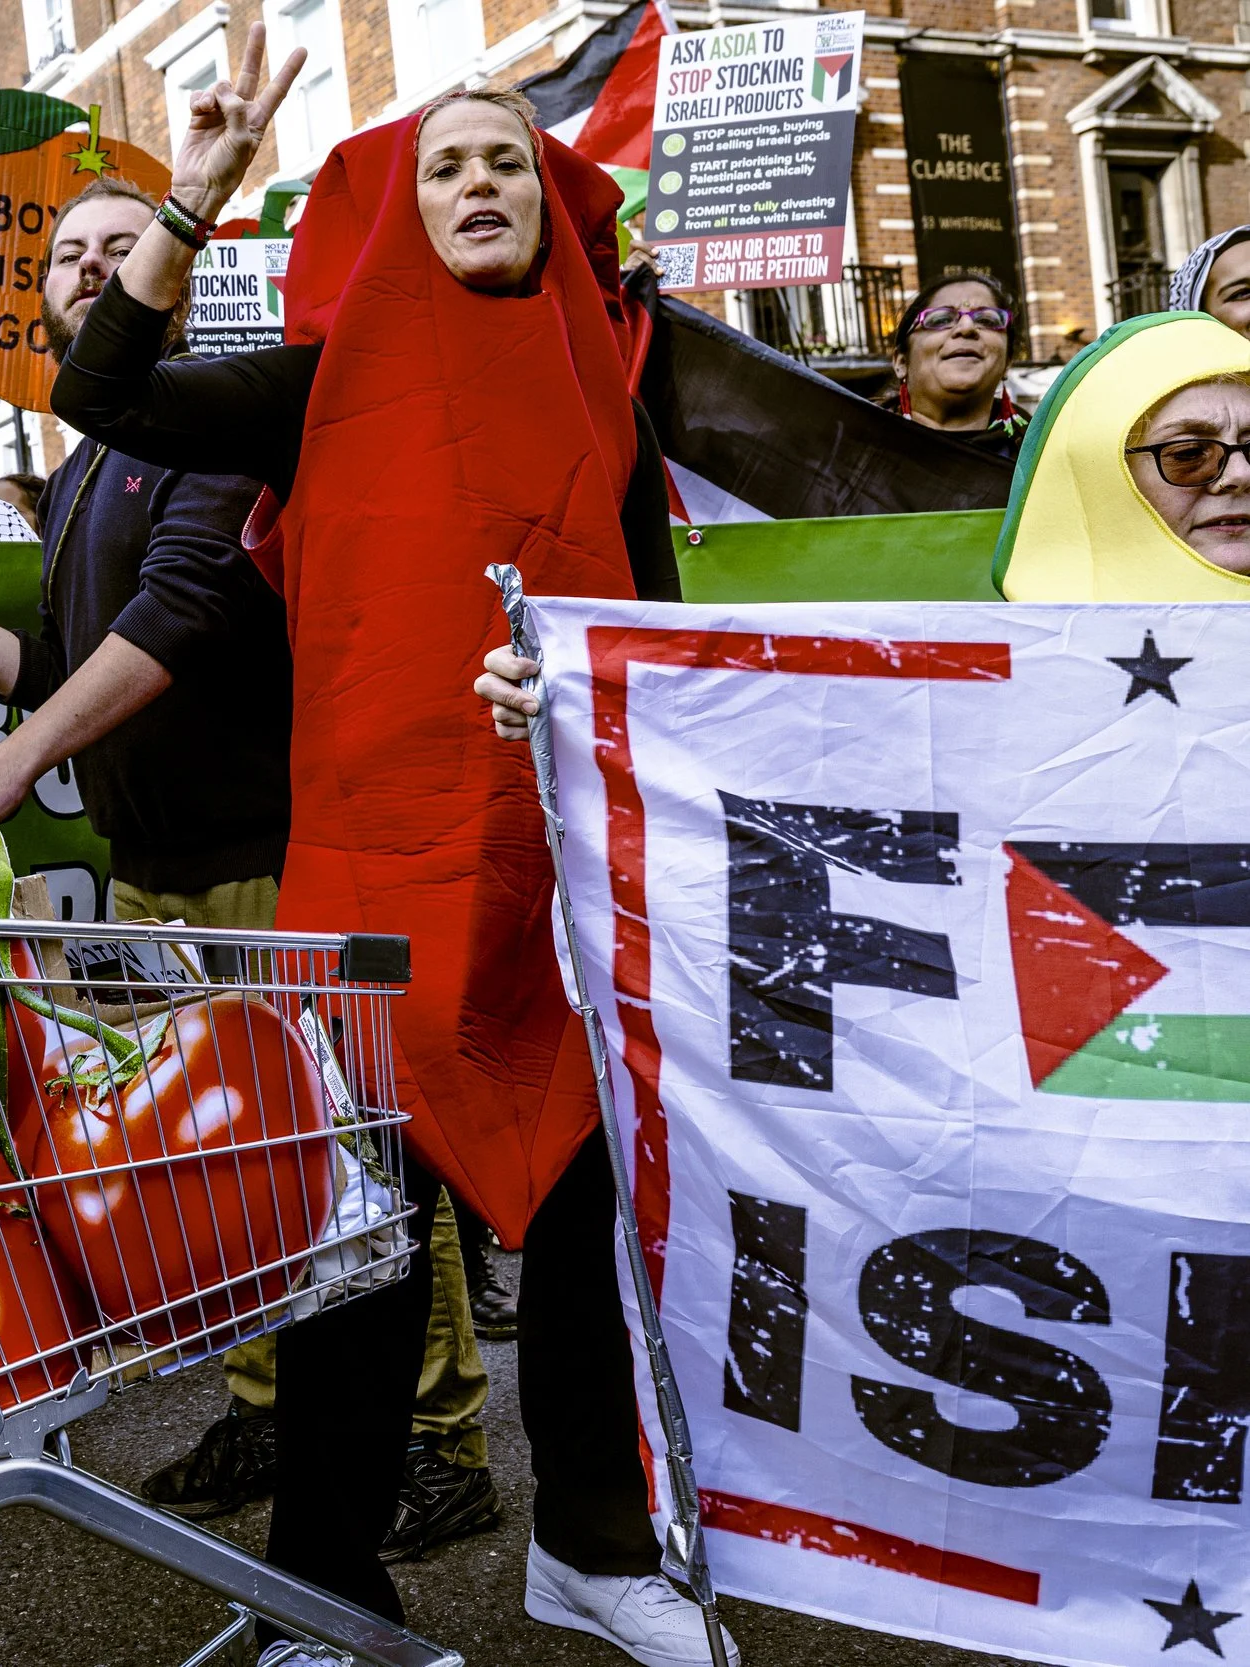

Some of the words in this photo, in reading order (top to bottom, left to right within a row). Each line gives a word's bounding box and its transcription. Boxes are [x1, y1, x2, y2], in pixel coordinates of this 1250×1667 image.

[670, 38, 706, 66] ASK
[710, 32, 757, 60] ASDA
[763, 28, 785, 54] TO
[668, 68, 712, 97] STOP
[716, 57, 804, 90] STOCKING
[665, 96, 721, 123] ISRAELI
[724, 87, 804, 116] PRODUCTS
[693, 128, 726, 141] STOP
[727, 123, 781, 138] sourcing,
[783, 119, 824, 134] buying
[692, 141, 714, 153] and
[716, 137, 754, 151] selling
[756, 133, 791, 147] Israeli
[793, 130, 831, 145] goods
[937, 133, 973, 154] THE
[690, 160, 728, 172] START
[730, 153, 793, 170] prioritising
[795, 151, 817, 163] UK,
[911, 158, 1003, 182] CLARENCE
[689, 170, 751, 184] Palestinian
[753, 168, 763, 179] &
[765, 164, 815, 178] ethically
[688, 183, 734, 197] sourced
[736, 180, 772, 195] goods
[686, 203, 737, 217] COMMIT
[739, 202, 751, 212] to
[753, 200, 780, 214] fully
[781, 196, 836, 211] divesting
[685, 219, 711, 231] from
[714, 217, 728, 228] all
[730, 215, 761, 227] trade
[763, 212, 789, 224] with
[791, 209, 827, 222] Israel.
[217, 246, 237, 268] TO
[705, 239, 742, 262] SCAN
[744, 237, 764, 260] QR
[766, 234, 803, 257] CODE
[802, 233, 823, 255] TO
[703, 261, 737, 285] SIGN
[738, 259, 764, 282] THE
[766, 256, 829, 281] PETITION
[192, 274, 258, 297] TOCKING
[192, 302, 262, 322] PRODUCTS
[196, 332, 244, 343] sourcing,
[246, 331, 282, 343] buying
[224, 342, 255, 353] Israeli
